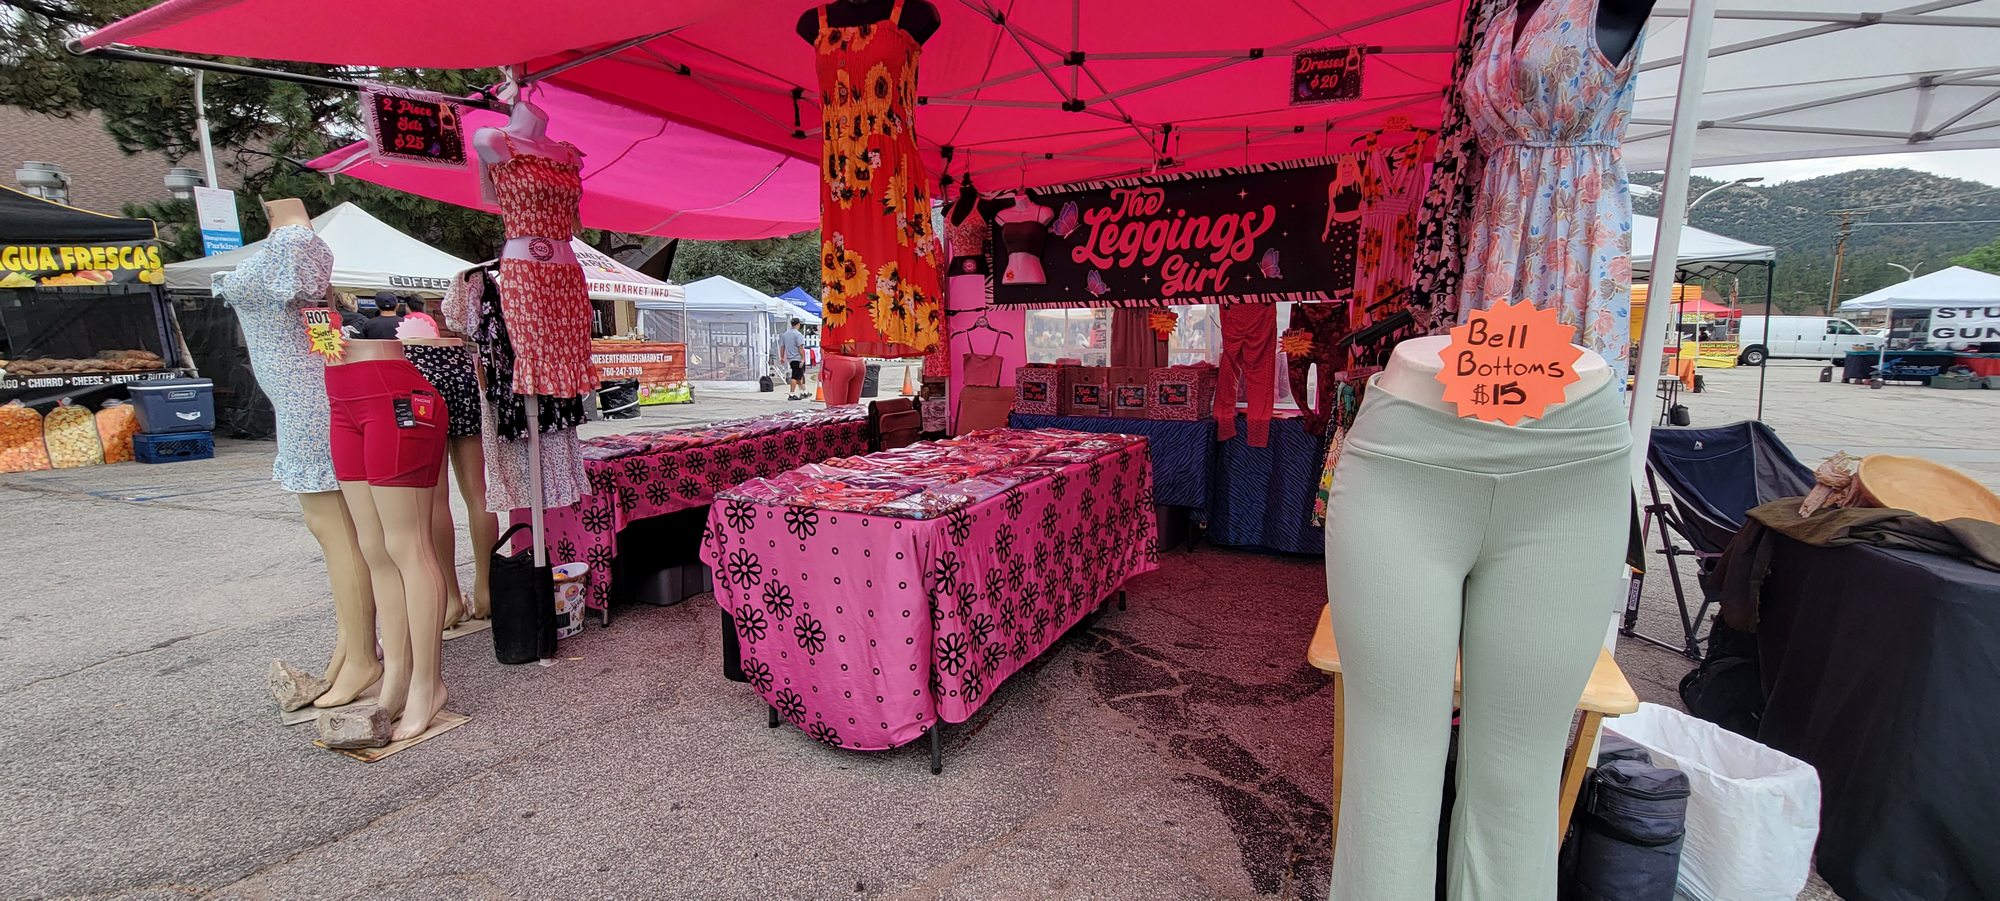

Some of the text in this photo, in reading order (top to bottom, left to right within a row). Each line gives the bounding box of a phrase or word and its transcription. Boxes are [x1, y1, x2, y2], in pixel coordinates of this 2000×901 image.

[1297, 57, 1345, 73] Dresses
[1311, 75, 1338, 89] $20
[383, 98, 432, 116] 2 Piece
[397, 117, 423, 131] Sets
[1387, 116, 1407, 125] PLUS
[395, 134, 424, 149] $25
[1110, 186, 1165, 222] The
[1071, 205, 1276, 270] Leggings
[60, 246, 161, 271] FRESCAS
[391, 276, 449, 289] COFFEE
[1161, 254, 1233, 296] Girl
[614, 284, 648, 296] MARKET
[650, 287, 669, 298] INFO
[306, 311, 330, 324] HOT
[1467, 318, 1528, 349] Bell
[1457, 350, 1565, 378] Bottoms
[28, 377, 63, 388] CHURRO
[72, 375, 104, 386] CHEESE
[1470, 381, 1527, 405] $15
